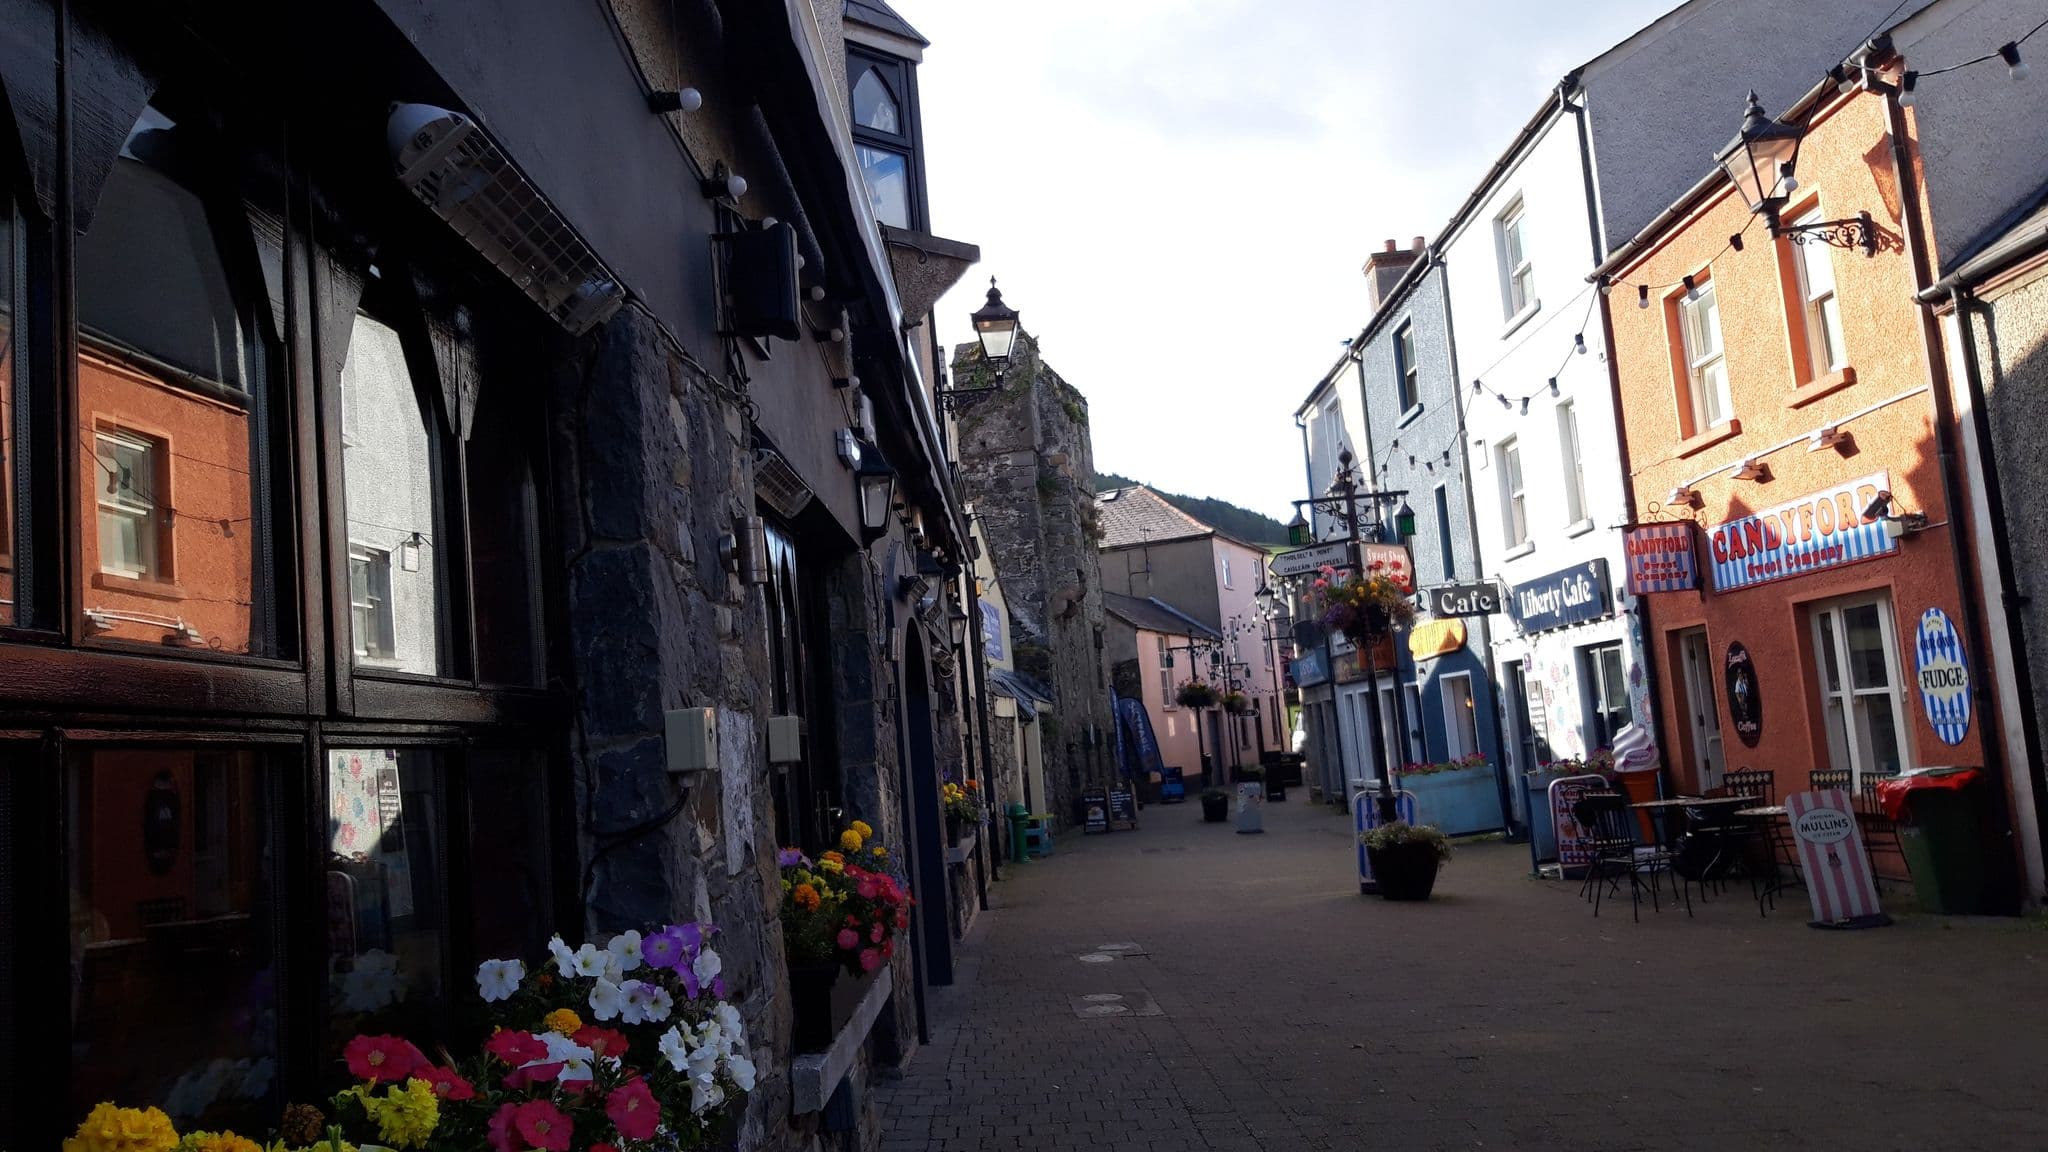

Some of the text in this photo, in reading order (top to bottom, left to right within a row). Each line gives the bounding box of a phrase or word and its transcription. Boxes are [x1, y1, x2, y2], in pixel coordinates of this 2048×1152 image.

[1712, 483, 1879, 565] CANDYFORD
[1366, 548, 1388, 563] Sweet
[1627, 535, 1690, 557] CANDYFORD
[1747, 543, 1844, 579] Sweet Company
[1635, 570, 1689, 582] Company
[1440, 590, 1493, 615] Cafe
[1519, 573, 1592, 619] Liberty Cafe
[1922, 666, 1965, 689] FUDGE
[1737, 720, 1757, 733] Coffee
[1801, 818, 1849, 833] MULLINS
